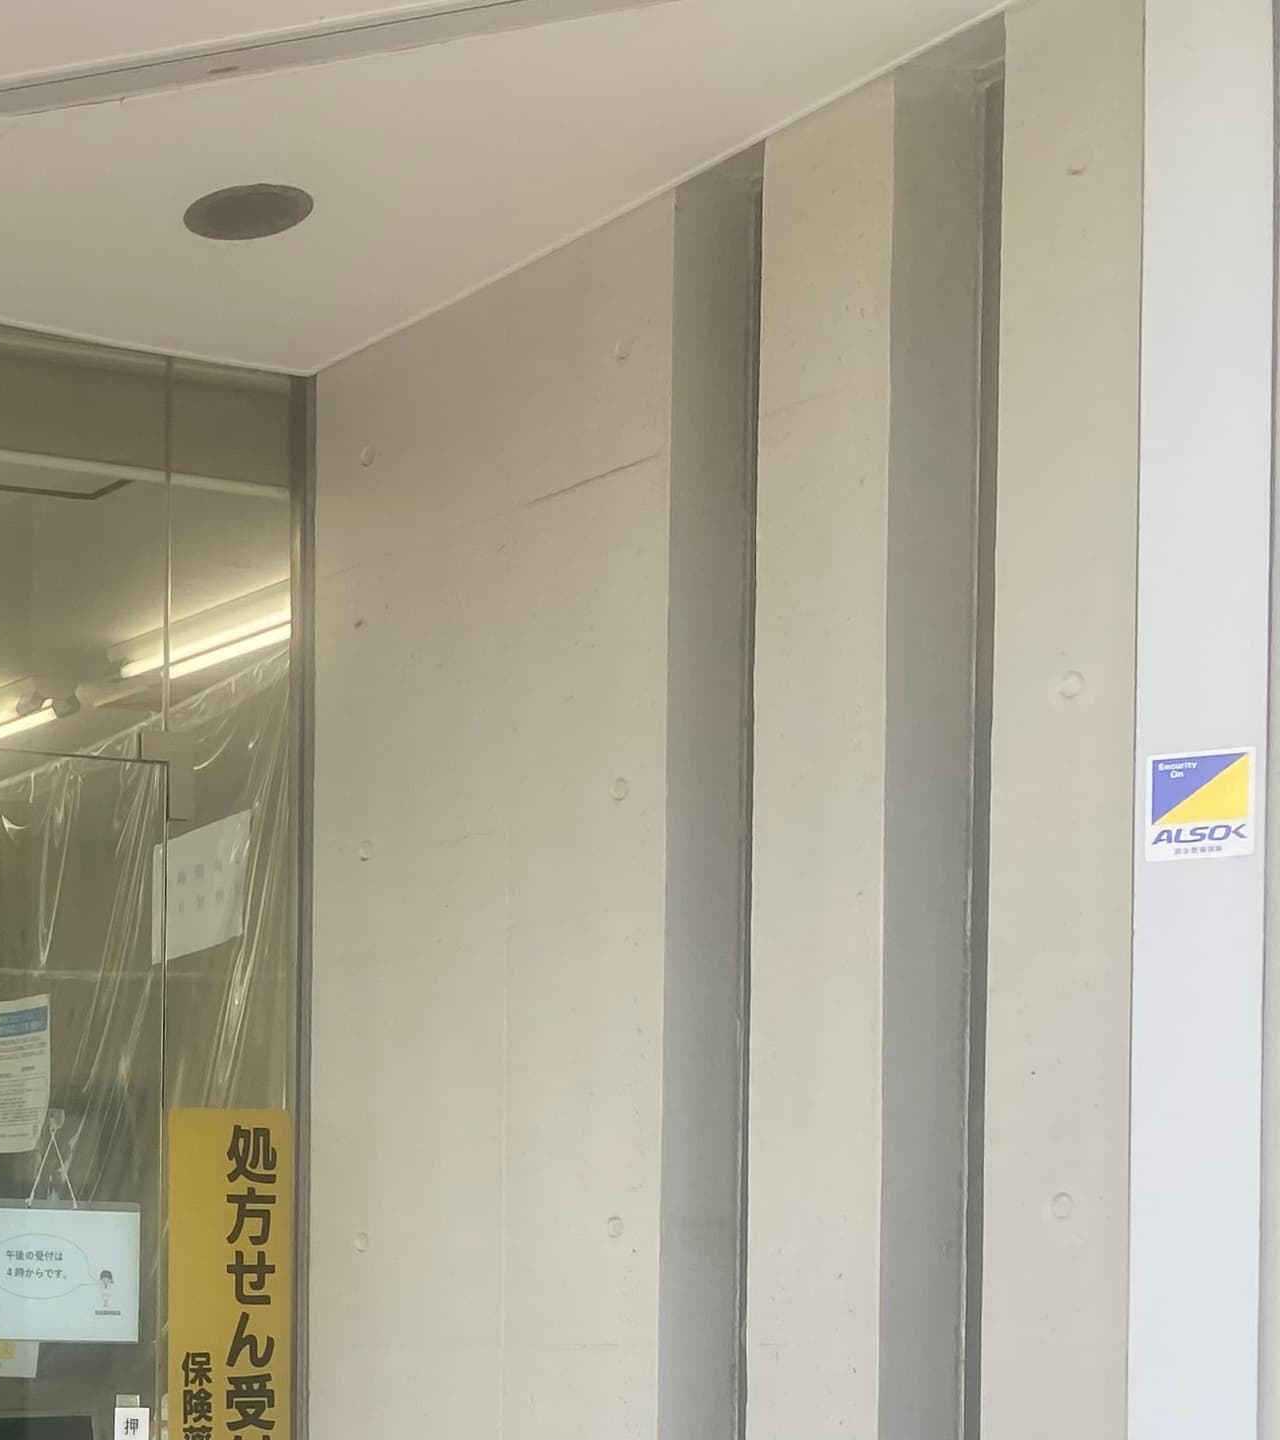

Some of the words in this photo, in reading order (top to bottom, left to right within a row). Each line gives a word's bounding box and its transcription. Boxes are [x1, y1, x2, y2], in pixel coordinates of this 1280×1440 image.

[1158, 761, 1198, 771] Security
[1170, 770, 1185, 779] On
[1151, 823, 1249, 846] ALSOK
[6, 1249, 64, 1262] 午後の受付は
